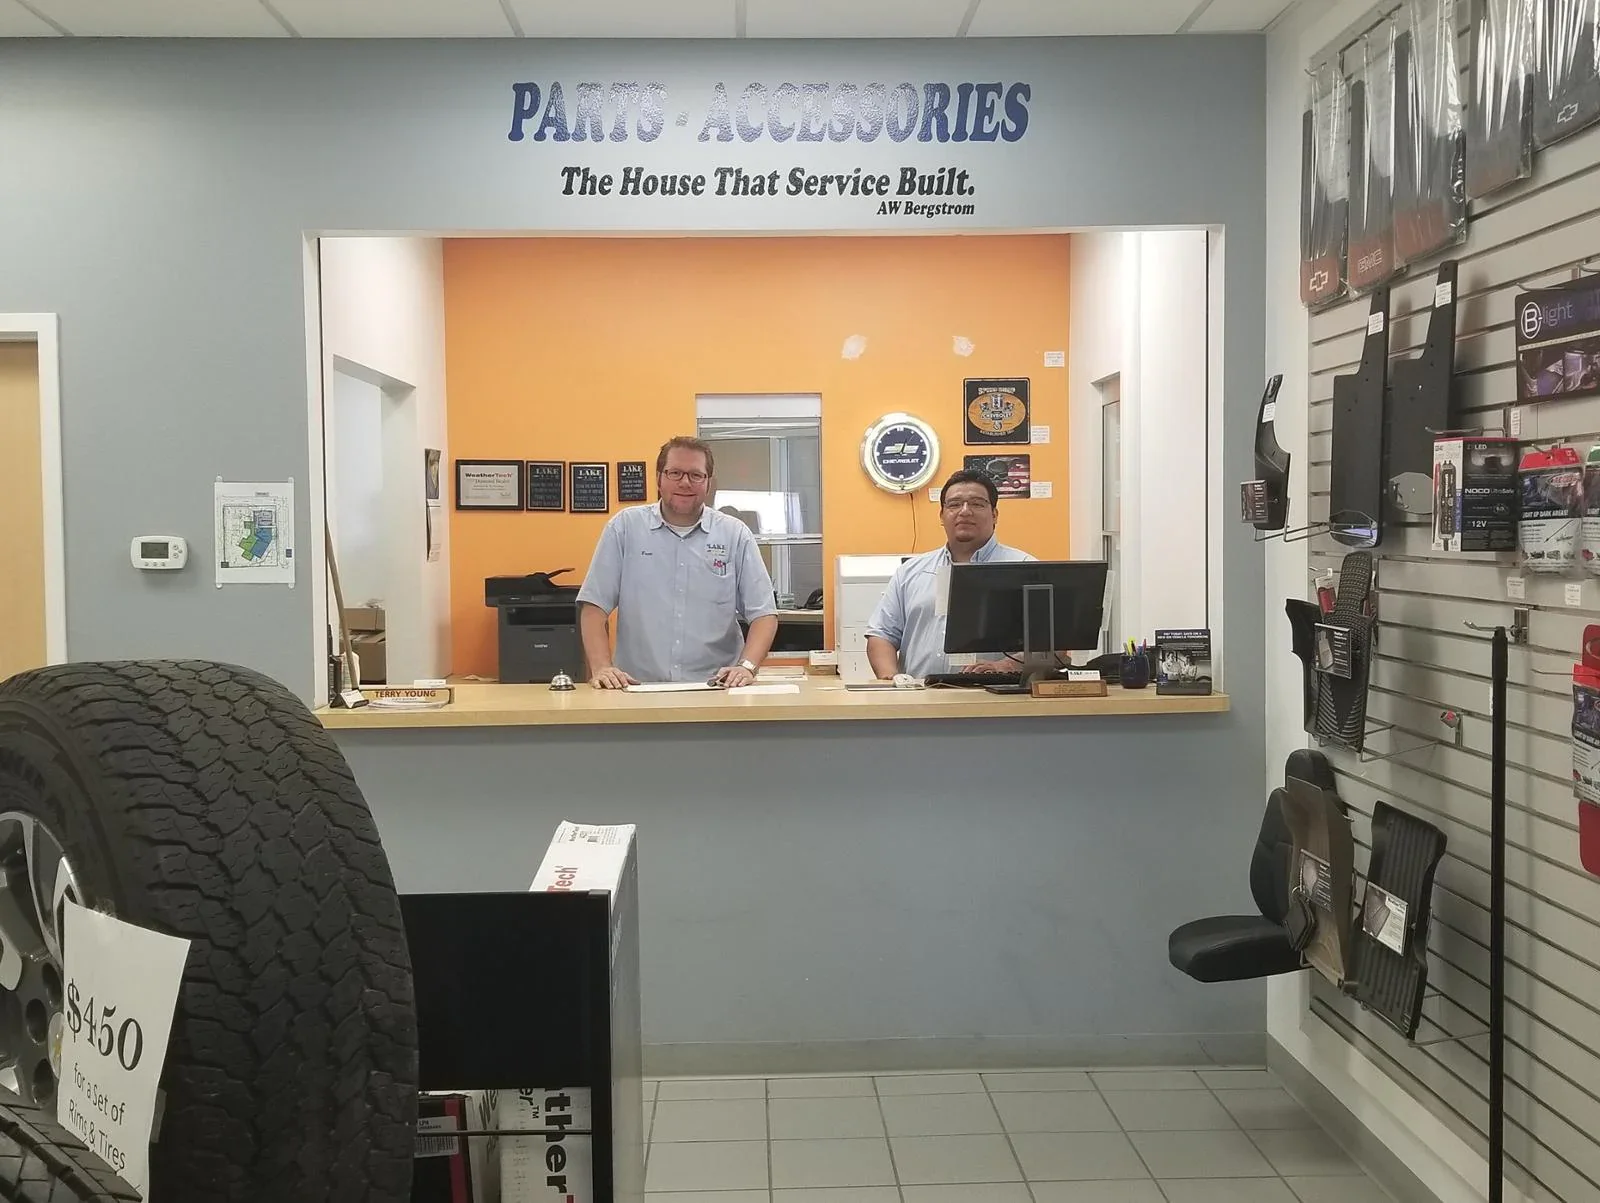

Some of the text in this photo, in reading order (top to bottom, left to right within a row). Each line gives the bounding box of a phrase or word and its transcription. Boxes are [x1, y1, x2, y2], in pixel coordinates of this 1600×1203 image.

[507, 82, 668, 142] PARTS
[697, 82, 1032, 142] ACCESSORIES
[560, 166, 975, 196] The House That Service Built.
[877, 200, 975, 219] AW Bergstrom
[1471, 520, 1487, 528] 12V
[375, 690, 436, 698] TERRY YOUNG
[66, 978, 143, 1071] $450
[74, 1062, 125, 1126] for a Set of
[69, 1098, 125, 1170] Rims & Tires
[545, 1088, 574, 1203] ther
